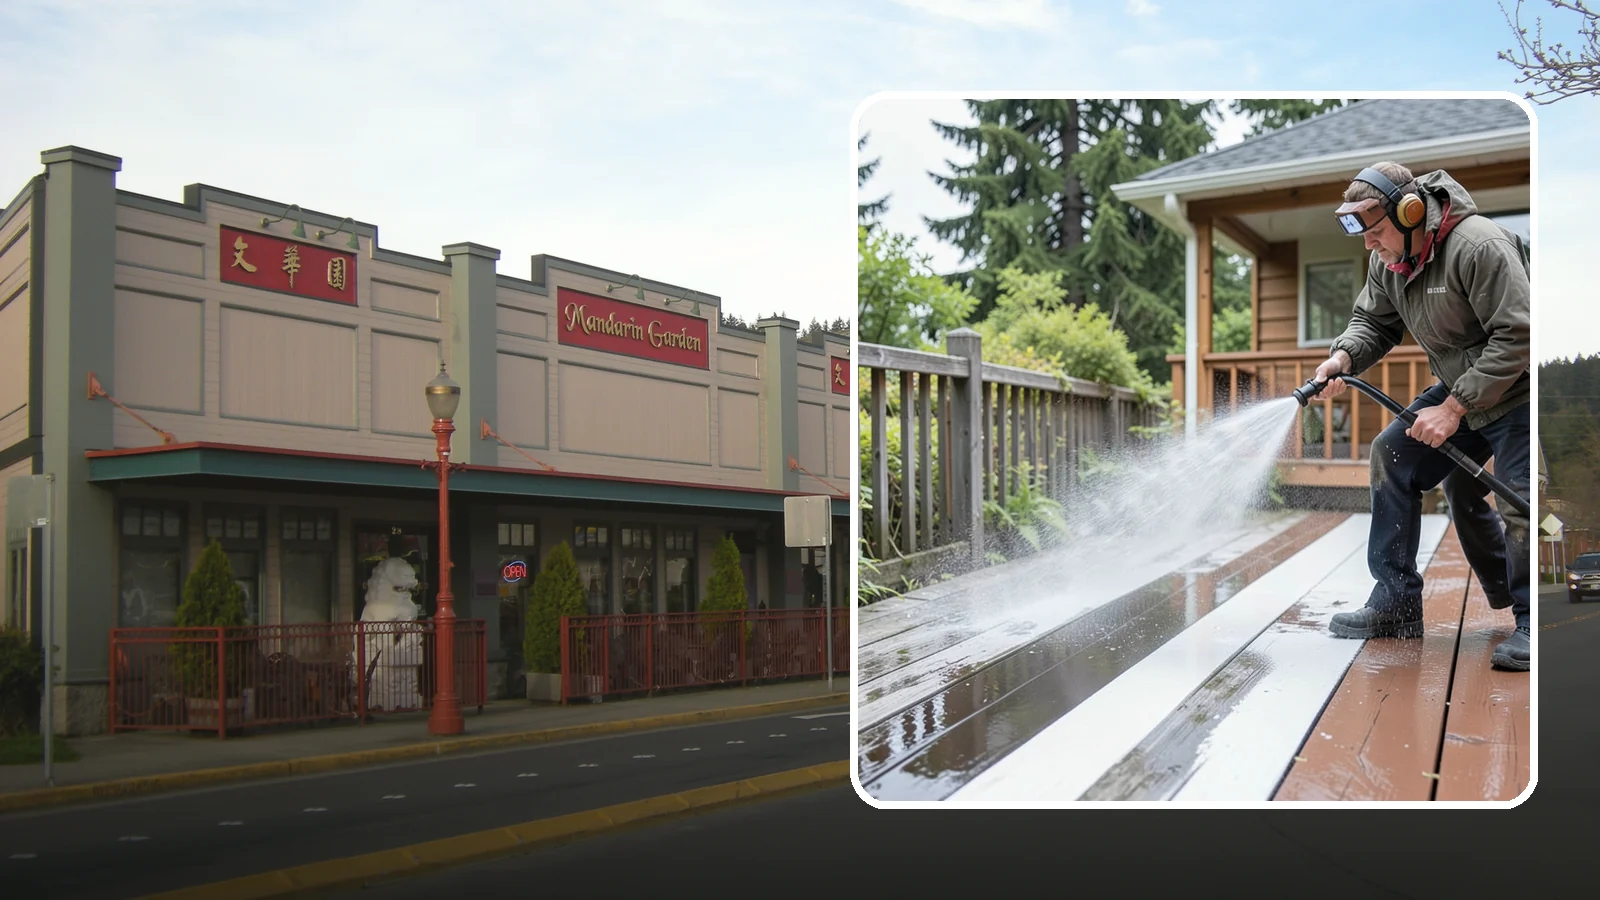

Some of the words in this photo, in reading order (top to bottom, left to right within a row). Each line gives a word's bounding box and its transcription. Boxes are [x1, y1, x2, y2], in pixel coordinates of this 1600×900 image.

[231, 235, 346, 291] 文華園
[564, 302, 644, 341] Mandarin
[648, 320, 702, 352] Garden
[503, 565, 527, 578] OPEN
